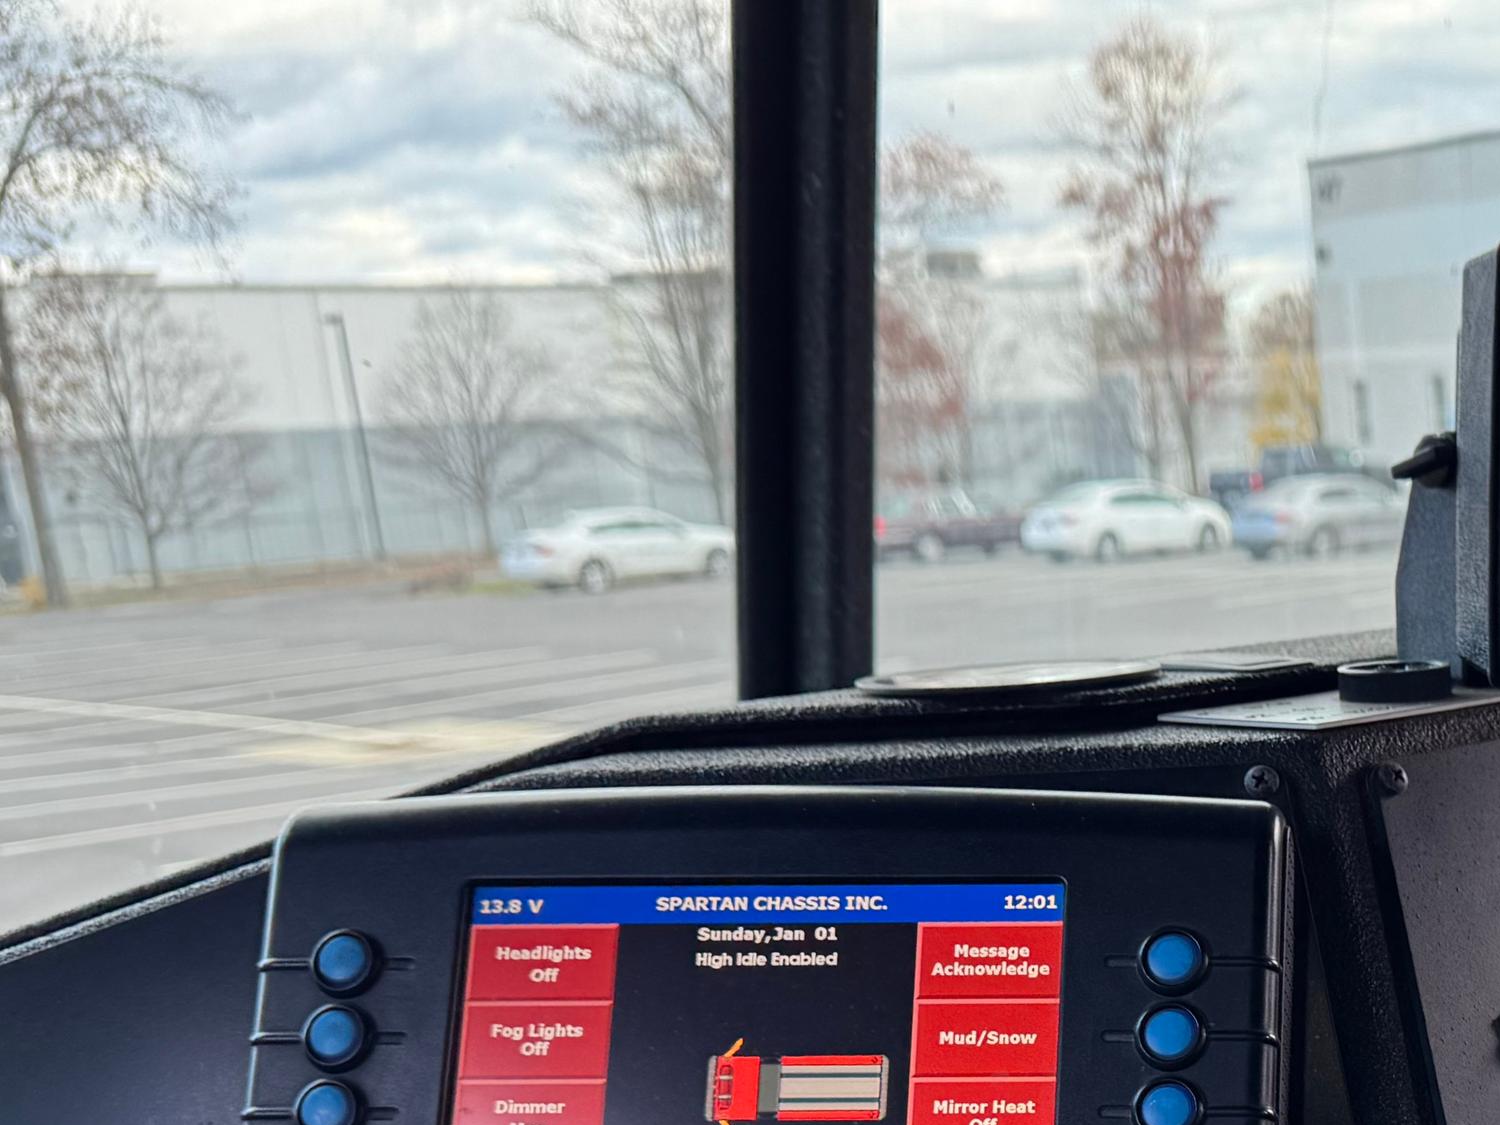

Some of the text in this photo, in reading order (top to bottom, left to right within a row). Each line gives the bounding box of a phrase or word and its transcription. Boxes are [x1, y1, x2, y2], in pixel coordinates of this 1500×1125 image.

[480, 899, 544, 914] 13.8 V
[656, 896, 888, 912] SPARTAN CHASSIS INC.
[1004, 895, 1057, 910] 12:01
[814, 926, 838, 942] 01
[495, 945, 592, 962] Headlights
[954, 944, 1030, 960] Message
[695, 952, 838, 969] High Idle Enabled
[529, 967, 560, 983] Off
[931, 961, 1050, 978] Acknowledge
[491, 1023, 584, 1040] Fog Lights
[939, 1030, 1037, 1047] Mud/Snow
[521, 1041, 550, 1056] Off
[495, 1099, 566, 1115] Dimmer
[933, 1099, 1036, 1114] Mirror Heat
